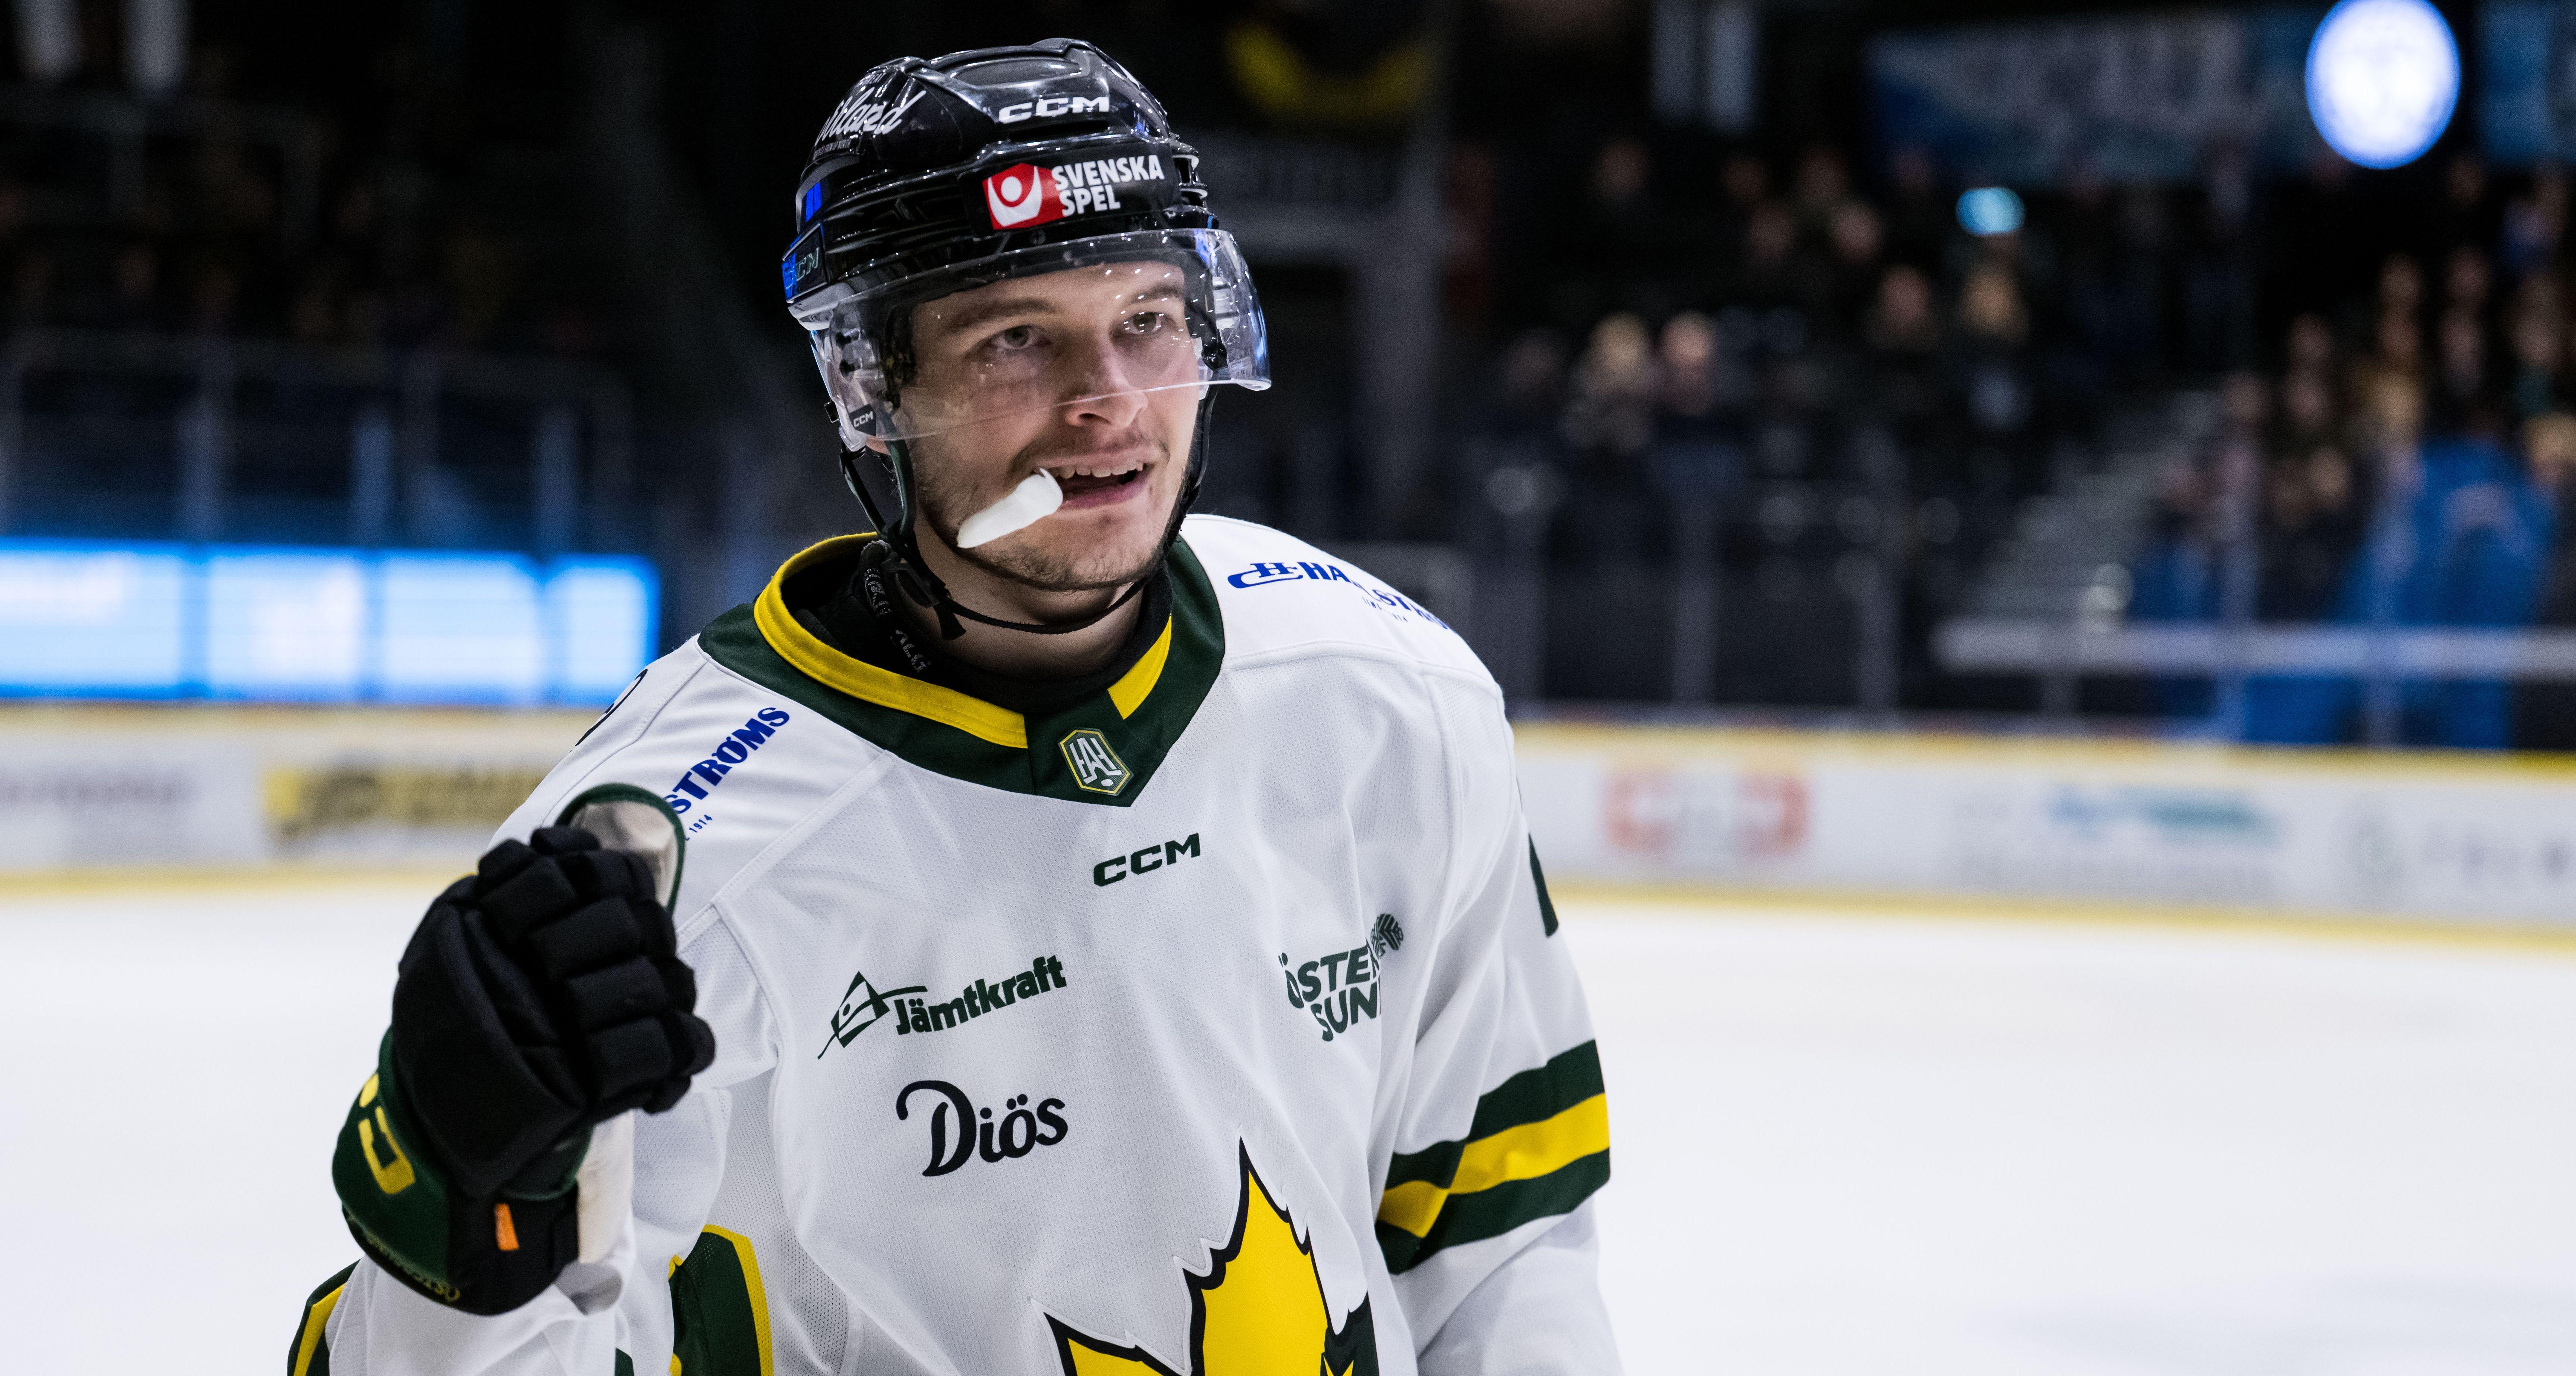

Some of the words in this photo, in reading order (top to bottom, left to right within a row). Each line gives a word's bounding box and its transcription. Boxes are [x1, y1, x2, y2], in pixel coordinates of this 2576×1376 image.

[998, 96, 1110, 124] CCM
[1051, 154, 1165, 191] SVENSKA
[1058, 184, 1121, 217] SPEL
[853, 410, 874, 428] CCM
[689, 814, 713, 833] 1914
[1093, 832, 1201, 887] CCM
[894, 954, 1067, 1035] Jämtkraft
[1310, 974, 1381, 1042] SUN
[896, 1080, 1068, 1177] Diös
